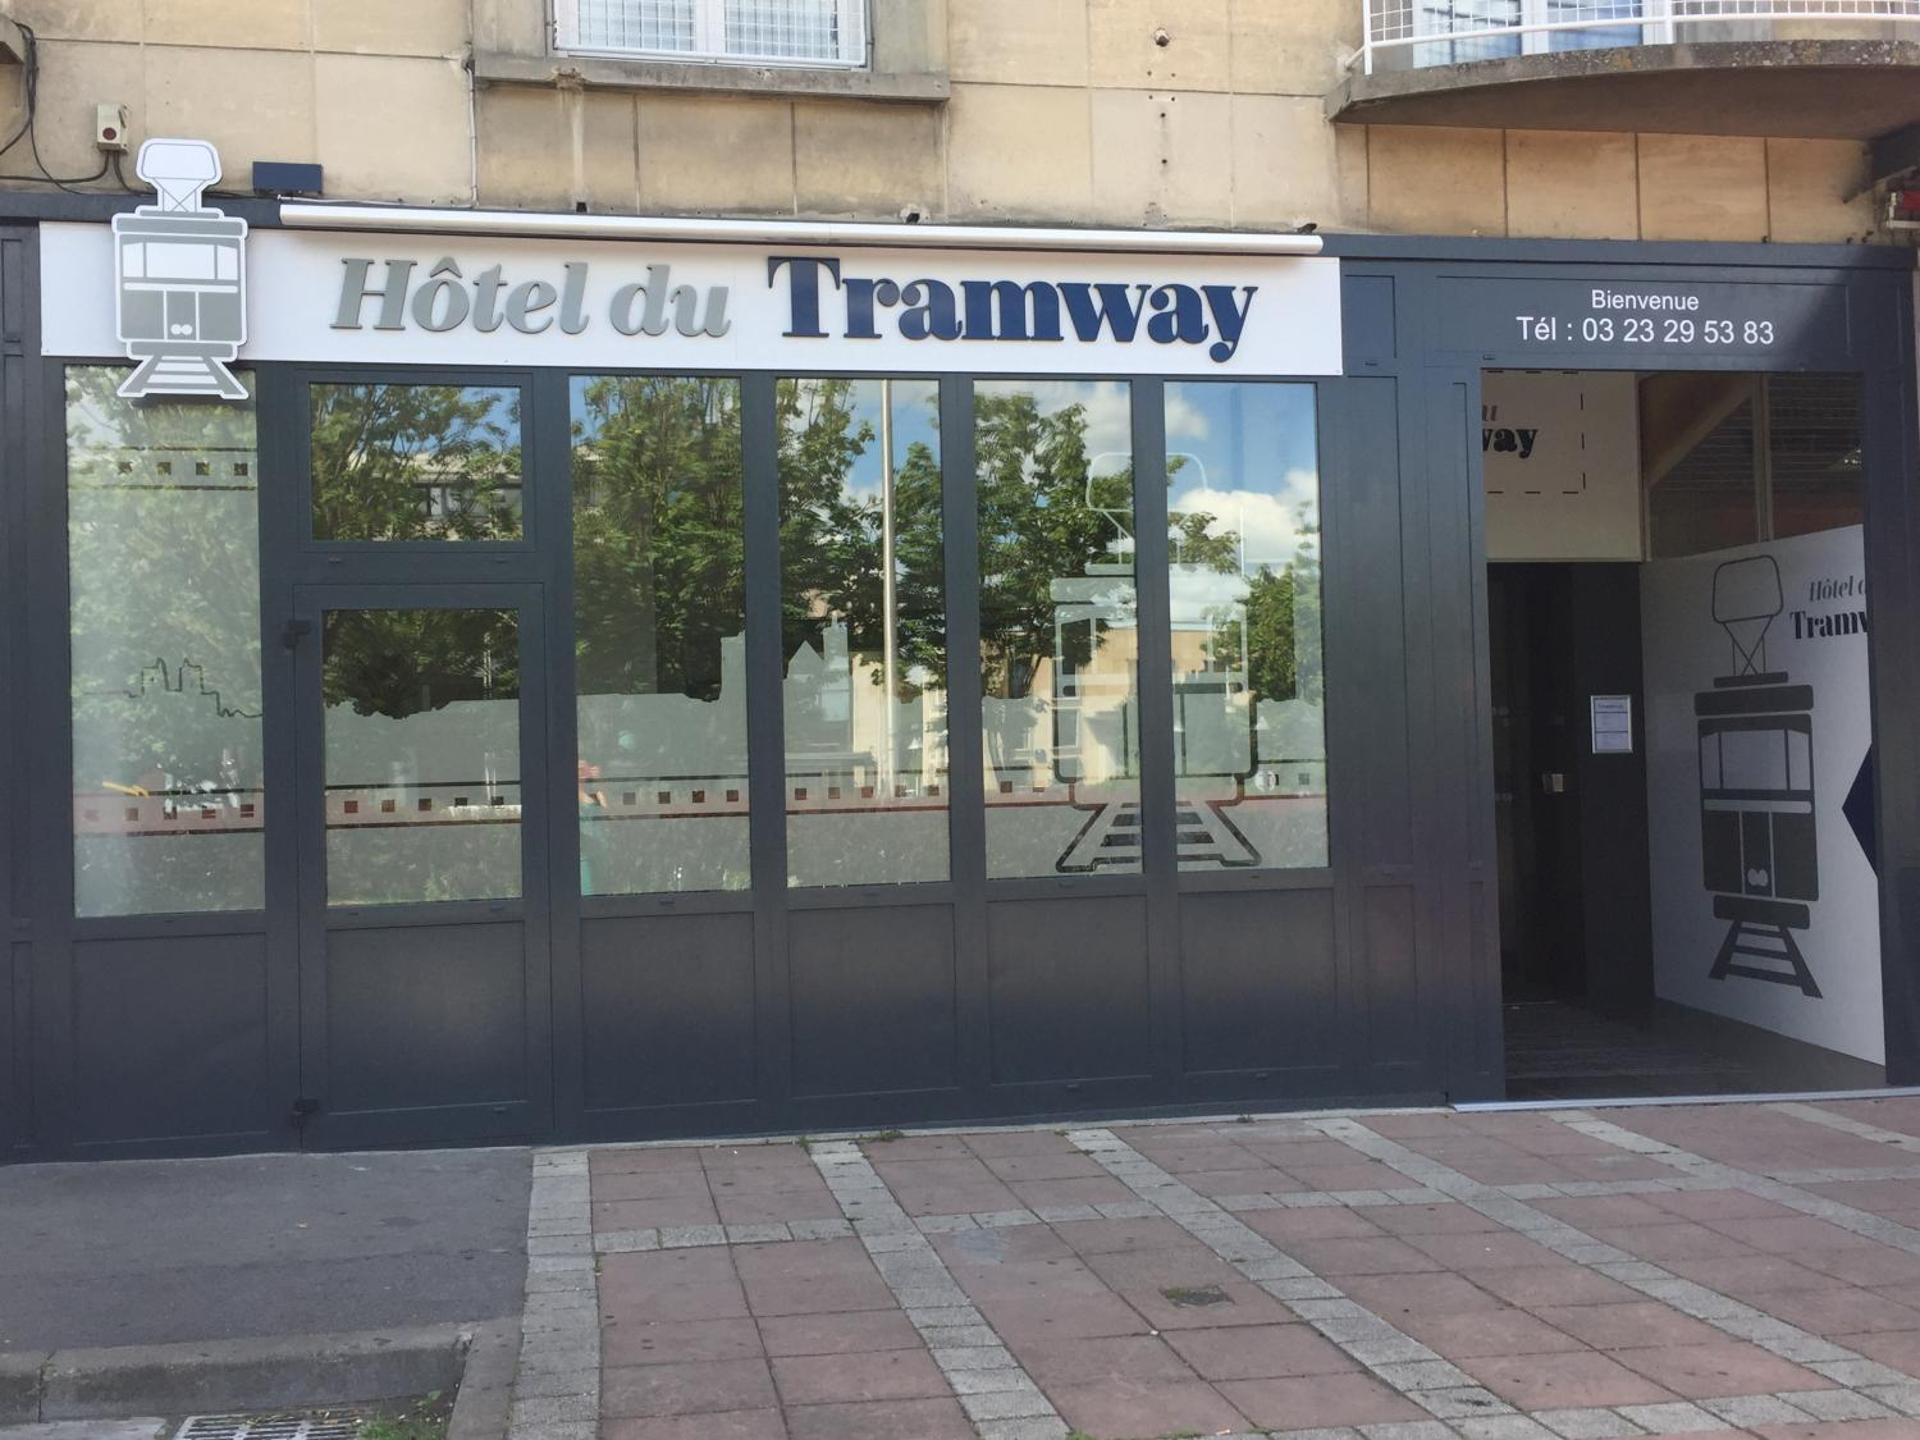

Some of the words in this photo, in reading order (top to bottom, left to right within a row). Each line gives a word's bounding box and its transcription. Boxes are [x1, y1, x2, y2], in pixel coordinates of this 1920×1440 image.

[330, 256, 590, 334] Hôtel
[609, 264, 732, 337] du
[767, 256, 1258, 363] Tramway
[1591, 289, 1700, 311] Bienvenue
[1516, 316, 1557, 341] Tél
[1582, 318, 1614, 341] 03
[1623, 319, 1655, 342] 23
[1663, 319, 1695, 343] 29
[1704, 320, 1735, 343] 53
[1744, 320, 1774, 344] 83
[1809, 575, 1853, 601] Hôtel
